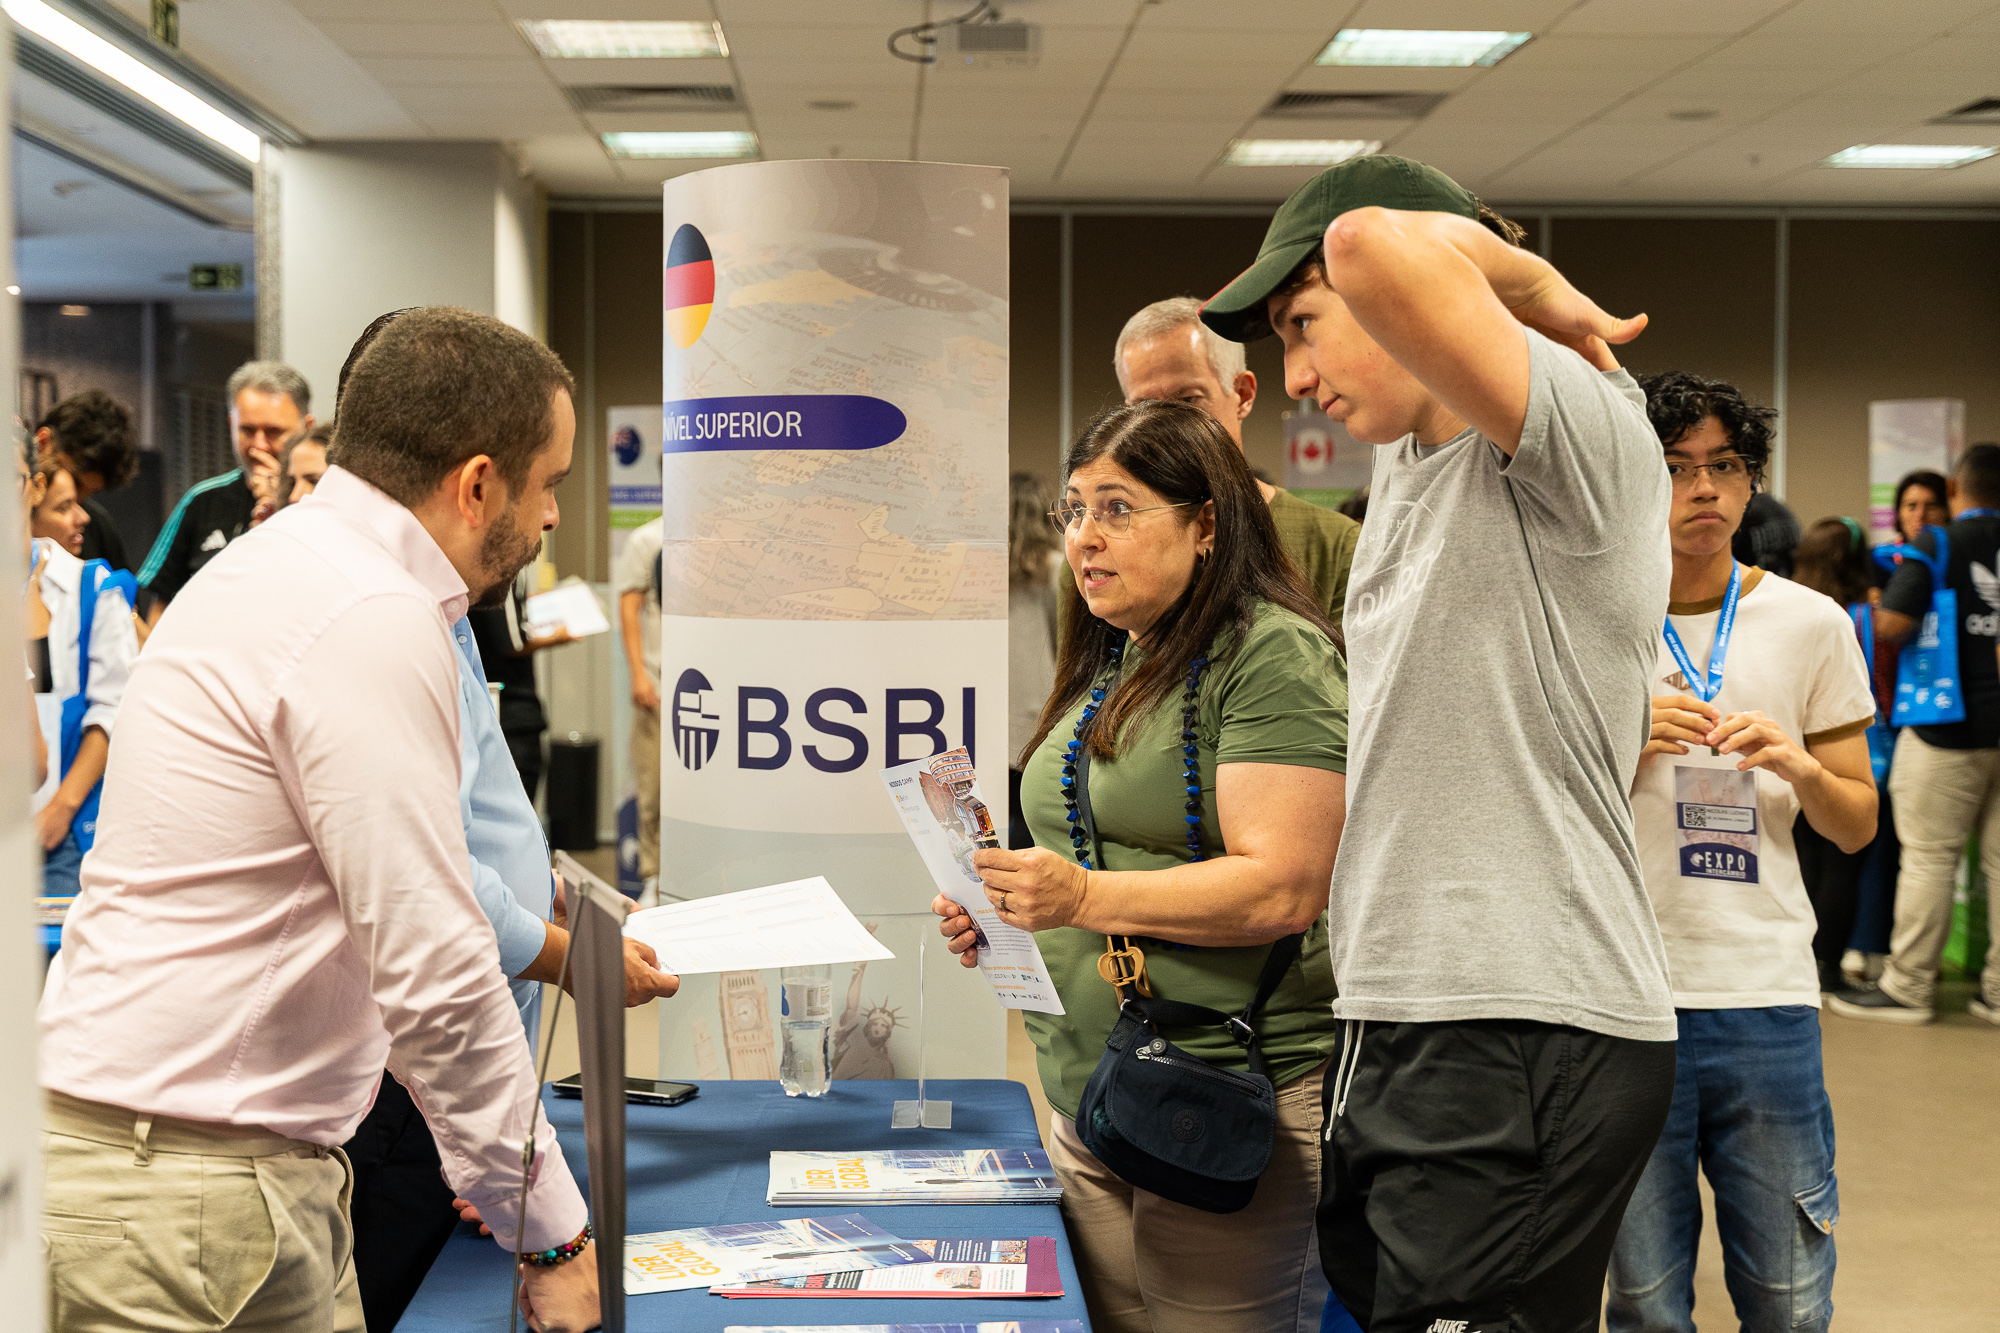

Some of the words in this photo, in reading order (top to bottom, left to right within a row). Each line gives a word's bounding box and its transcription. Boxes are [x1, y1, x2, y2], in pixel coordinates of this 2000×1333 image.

[663, 411, 693, 442] NÍVEL
[695, 410, 803, 440] SUPERIOR
[1718, 569, 1740, 648] www.expointercambio.com
[738, 686, 976, 774] BSBI
[1704, 851, 1746, 871] EXPO
[800, 1169, 837, 1189] LÍDER
[836, 1158, 870, 1189] GLOBAL
[632, 1254, 687, 1280] LÍDER
[653, 1240, 721, 1276] GLOBAL
[1432, 1319, 1469, 1333] NIKE
